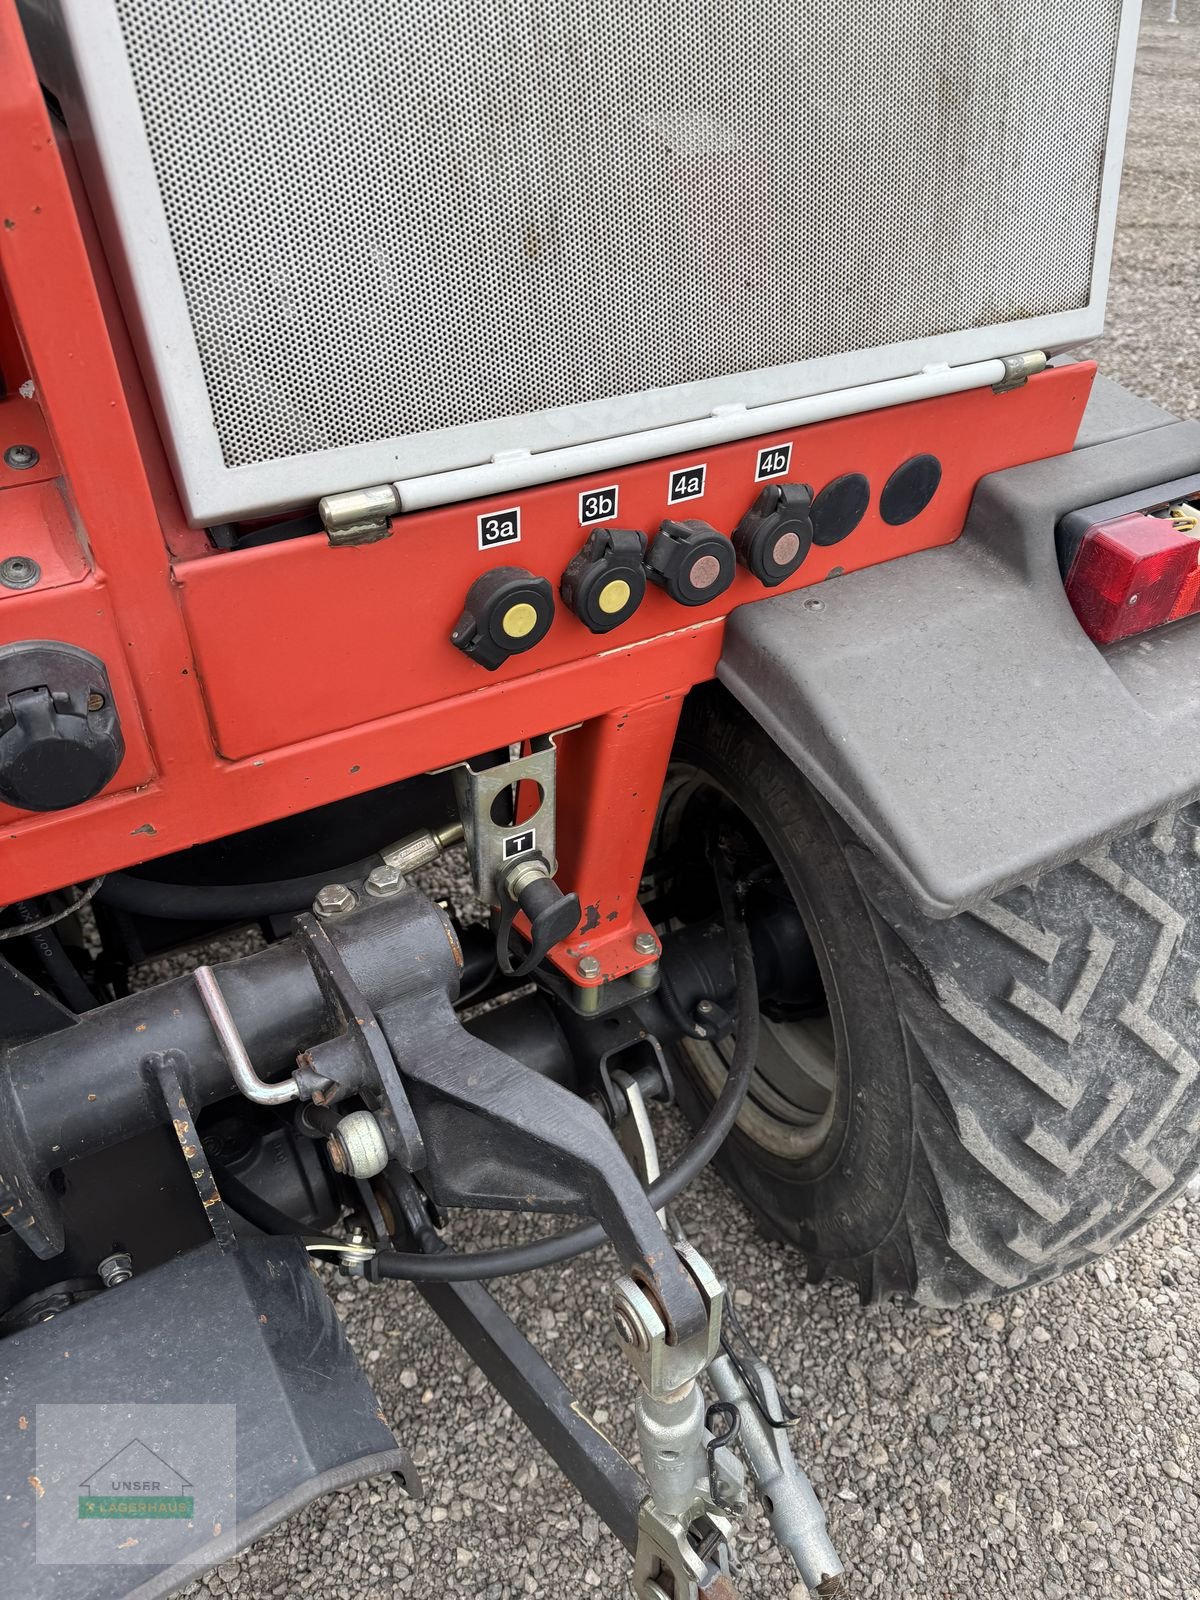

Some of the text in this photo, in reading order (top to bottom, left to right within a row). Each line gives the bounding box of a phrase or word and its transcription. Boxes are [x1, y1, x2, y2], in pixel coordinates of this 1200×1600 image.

[762, 452, 786, 473] 4b
[675, 475, 700, 495] 4a
[586, 494, 613, 517] 3b
[485, 520, 515, 541] 3a
[512, 837, 526, 851] T
